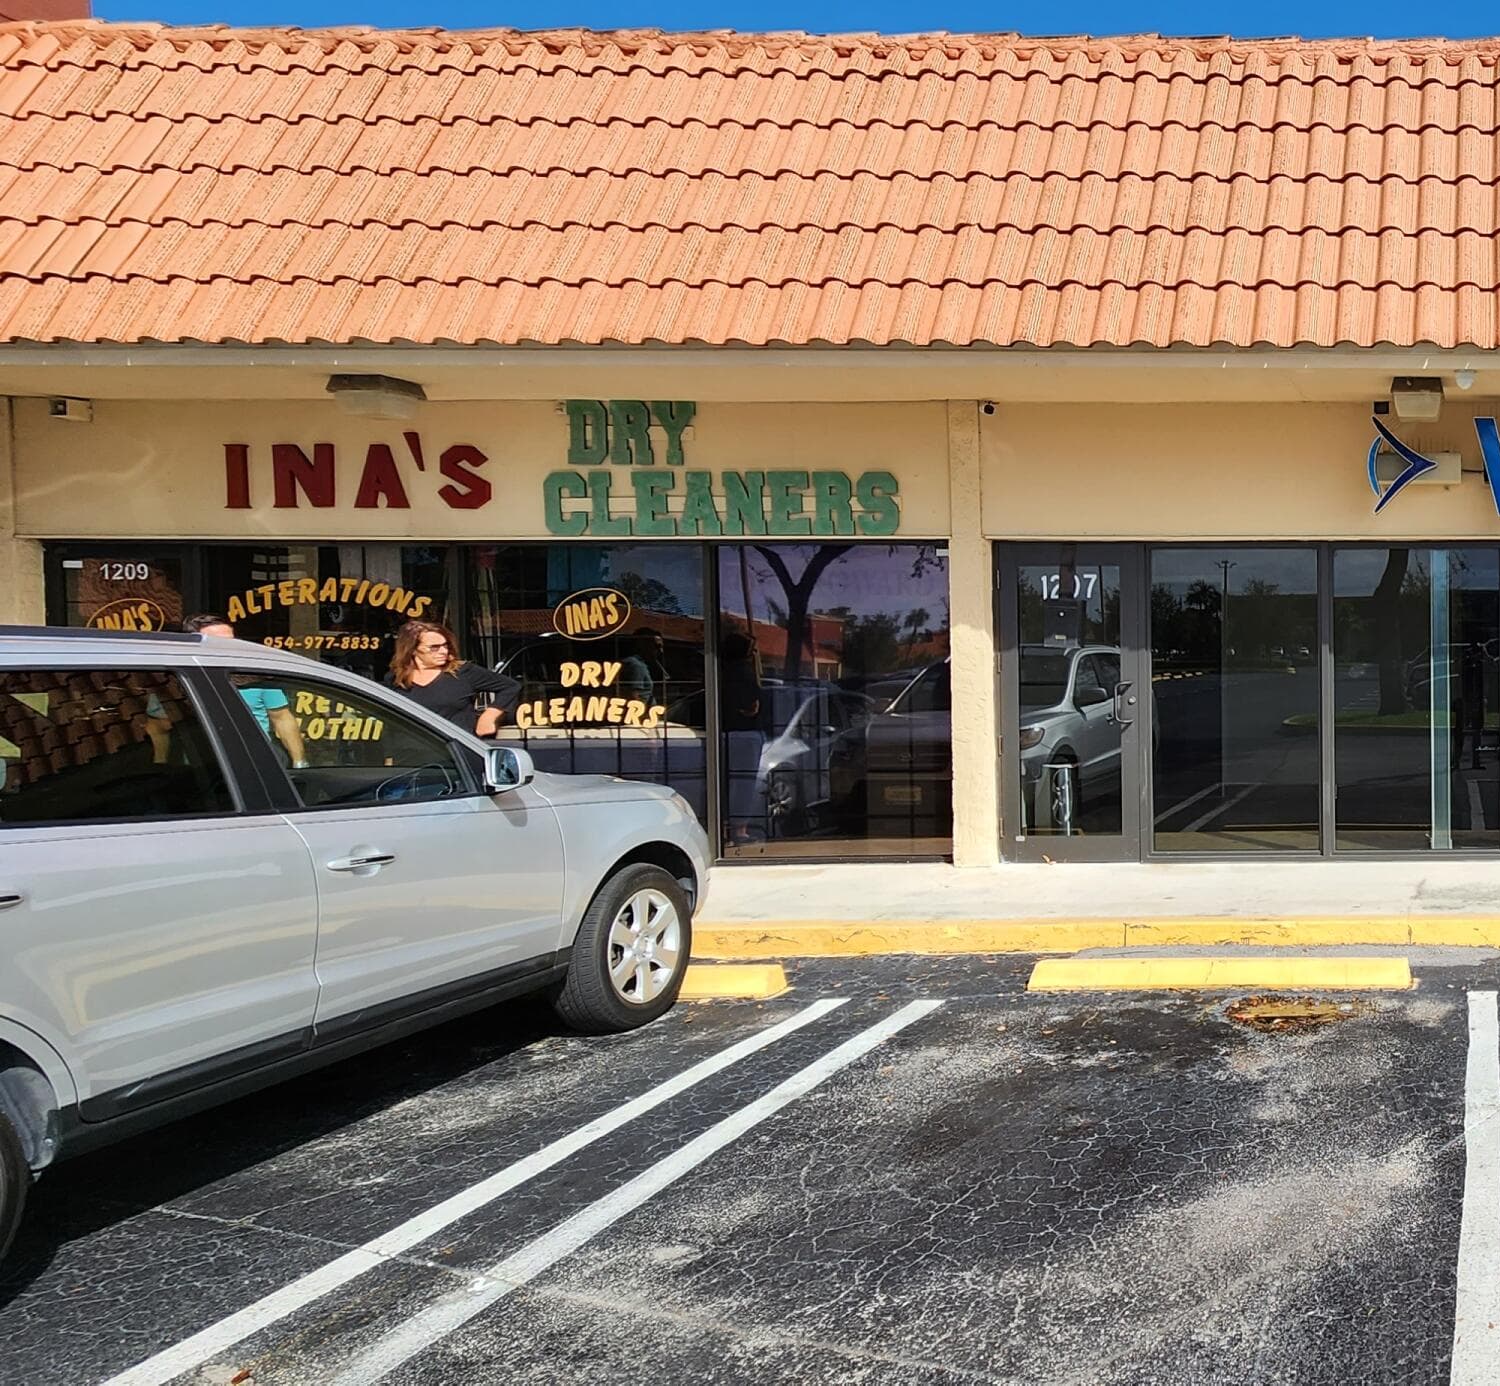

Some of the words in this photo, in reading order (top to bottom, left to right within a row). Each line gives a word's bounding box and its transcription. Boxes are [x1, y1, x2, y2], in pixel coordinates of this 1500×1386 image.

[566, 400, 696, 465] DRY
[222, 431, 492, 510] INA'S
[543, 471, 901, 536] CLEANERS
[100, 563, 149, 580] 1209
[227, 577, 433, 623] ALTERATIONS
[564, 593, 620, 635] INA'S
[263, 636, 380, 649] 954-977-8833
[560, 661, 622, 688] DRY
[516, 696, 666, 729] CLEANERS
